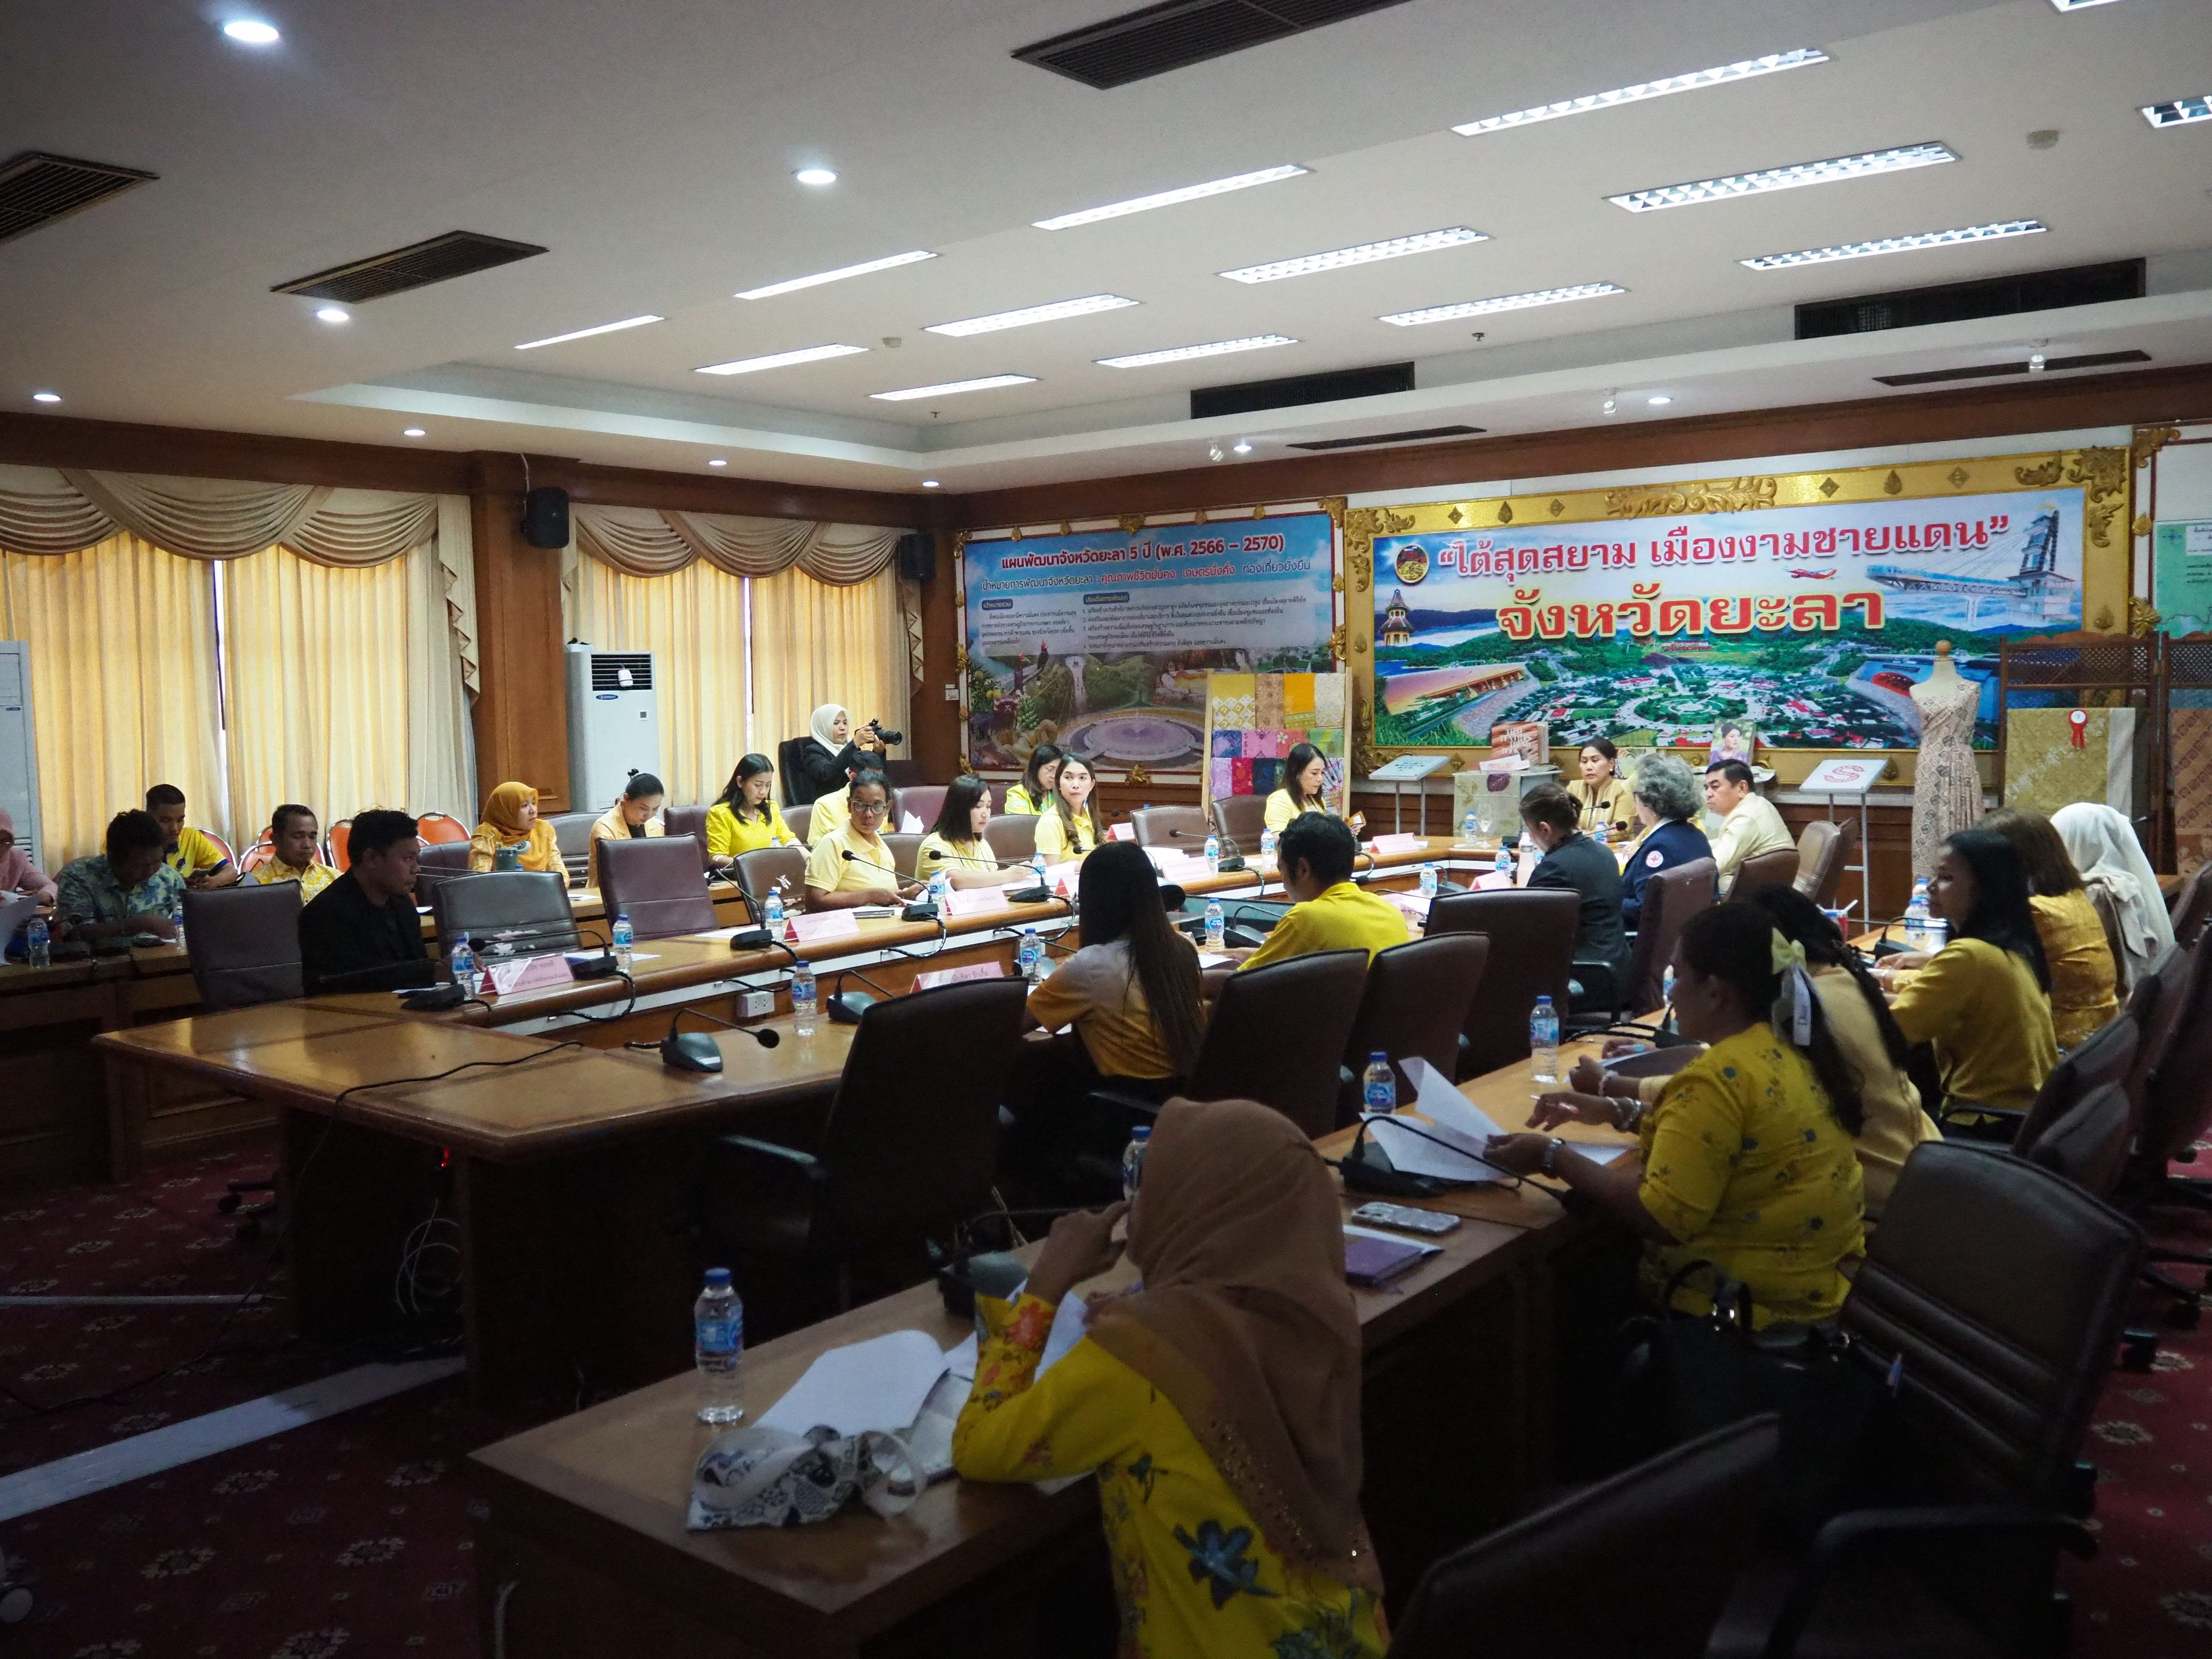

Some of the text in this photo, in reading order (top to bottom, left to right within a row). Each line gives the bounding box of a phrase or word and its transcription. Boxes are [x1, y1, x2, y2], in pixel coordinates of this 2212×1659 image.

[1002, 548, 1126, 569] แผนพัฒนาจังหวัดยะลา
[1130, 546, 1138, 560] 5
[1142, 540, 1151, 559] ปี
[1155, 543, 1186, 561] (พ.ศ.
[1190, 539, 1224, 555] 2566
[1243, 535, 1285, 552] 2570)
[1440, 515, 2008, 582] “ใต้สุดสยาม เมืองงามชายแดน”
[1497, 581, 1884, 638] จังหวัดยะลา
